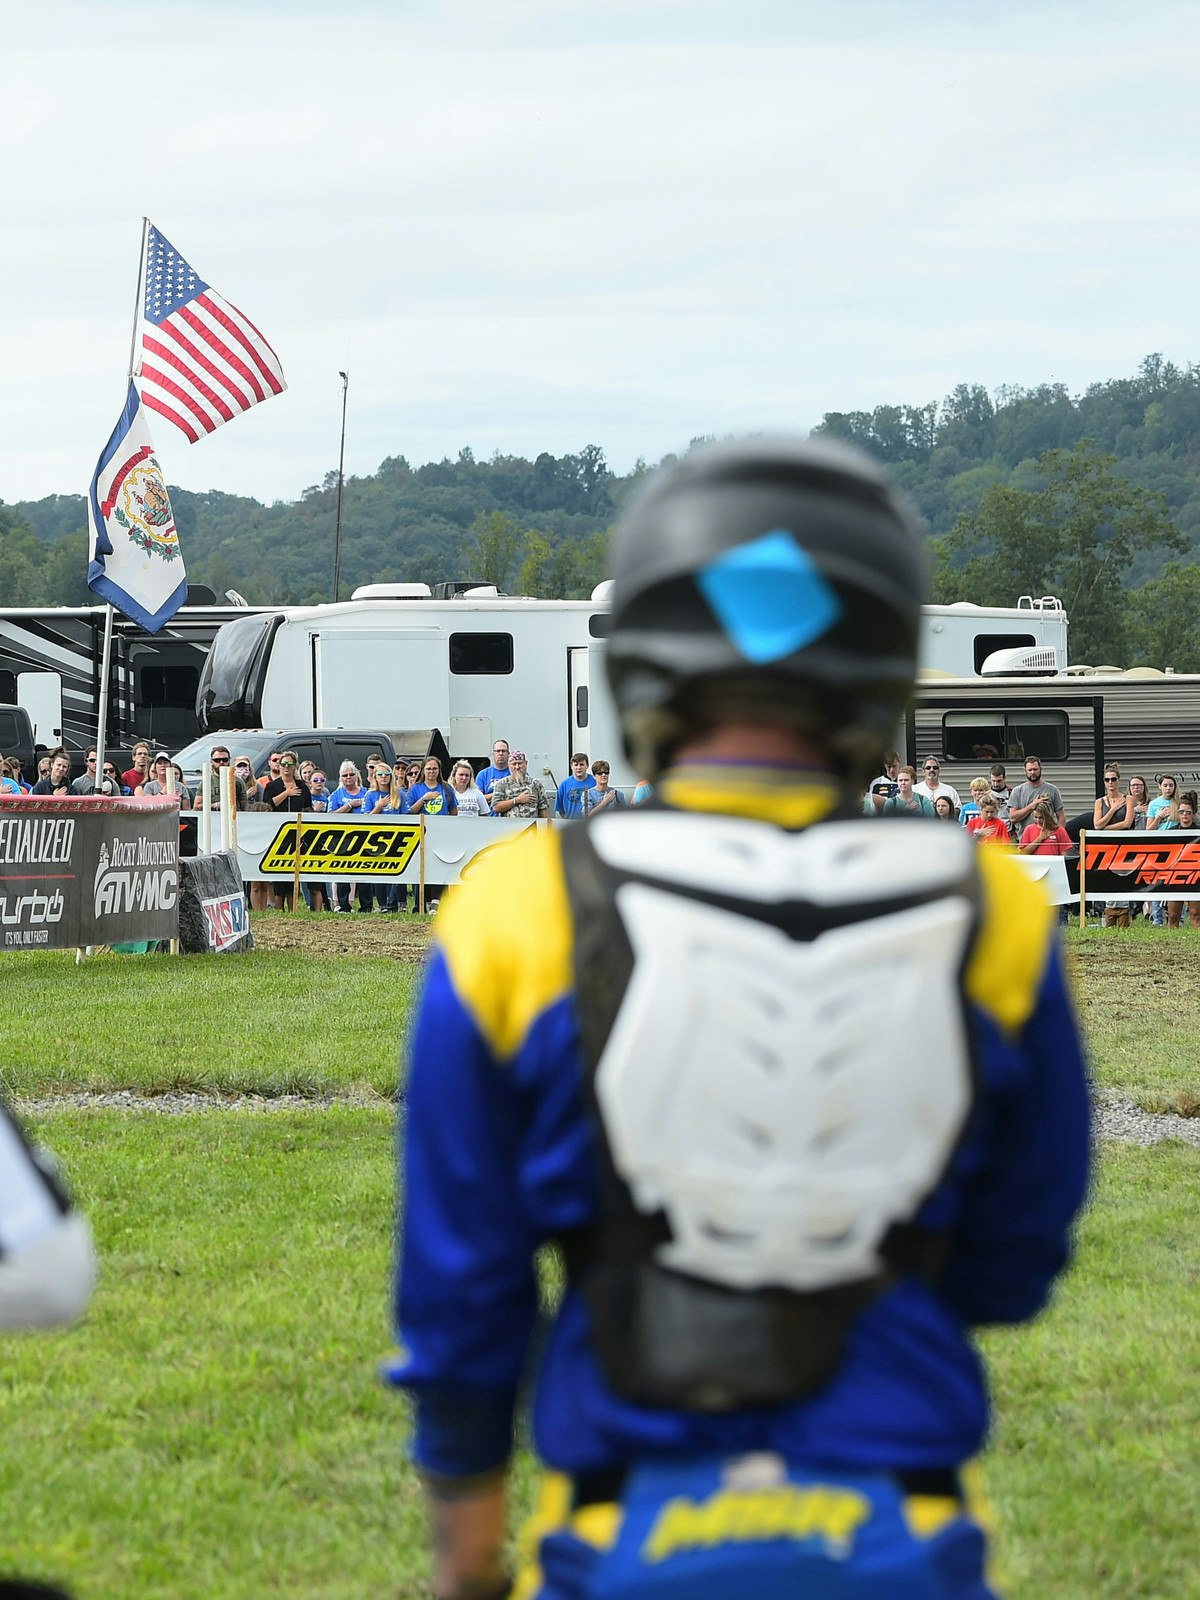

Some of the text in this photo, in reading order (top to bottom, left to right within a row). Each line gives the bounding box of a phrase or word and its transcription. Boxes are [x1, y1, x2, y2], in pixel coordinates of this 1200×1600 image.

[110, 836, 176, 868] ROCKY MOUNTAIN
[275, 829, 415, 858] MOOSE
[1077, 843, 1200, 870] MOOS
[329, 859, 401, 870] DIVISION
